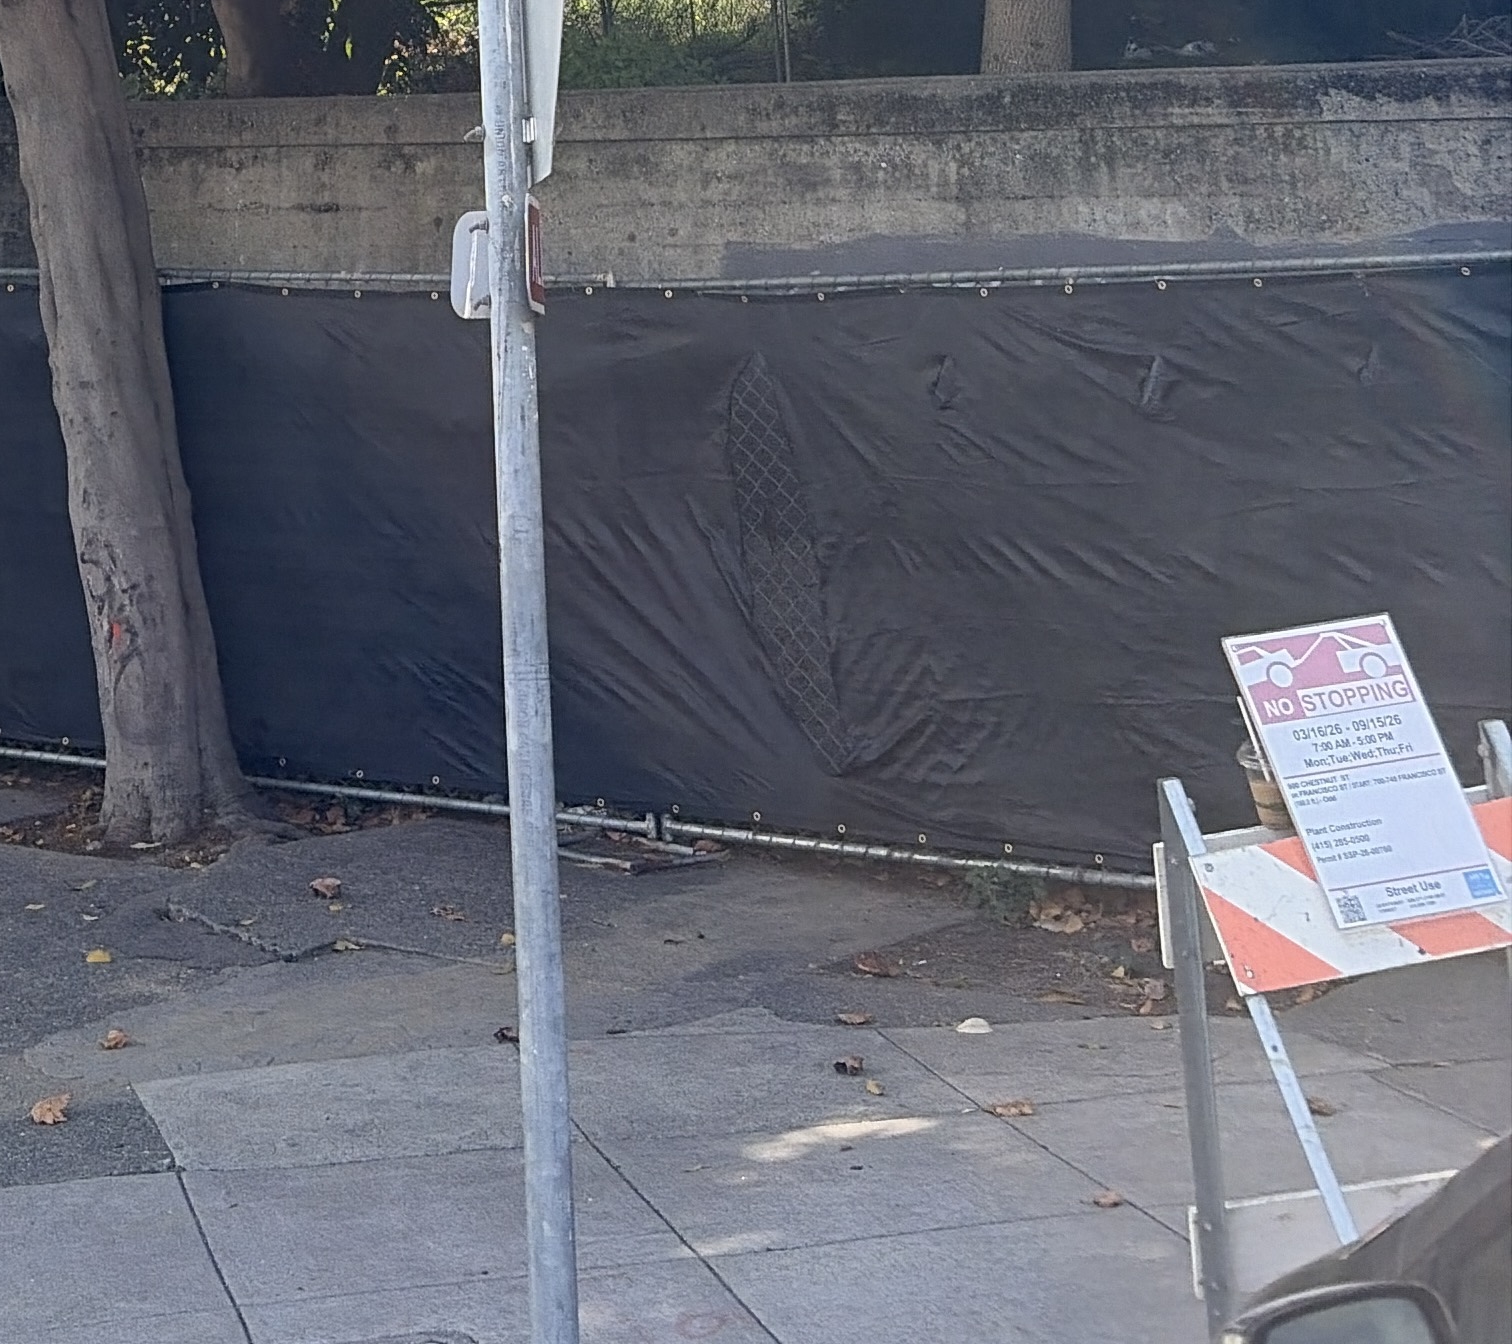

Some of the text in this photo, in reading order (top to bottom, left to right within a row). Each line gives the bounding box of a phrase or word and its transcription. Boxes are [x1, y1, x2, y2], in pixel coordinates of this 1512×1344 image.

[1263, 680, 1409, 718] NO STOPPING
[1292, 723, 1343, 741] 03/16/26
[1352, 714, 1403, 732] 09/15/26
[1312, 741, 1334, 753] 7:00
[1335, 738, 1351, 749] AM
[1356, 734, 1377, 746] 5:00
[1378, 731, 1395, 742] PM
[1300, 776, 1337, 787] CHESTNUT
[1306, 819, 1382, 836] Plant Construction
[1311, 840, 1333, 852] (415)
[1385, 880, 1441, 897] Street Use
